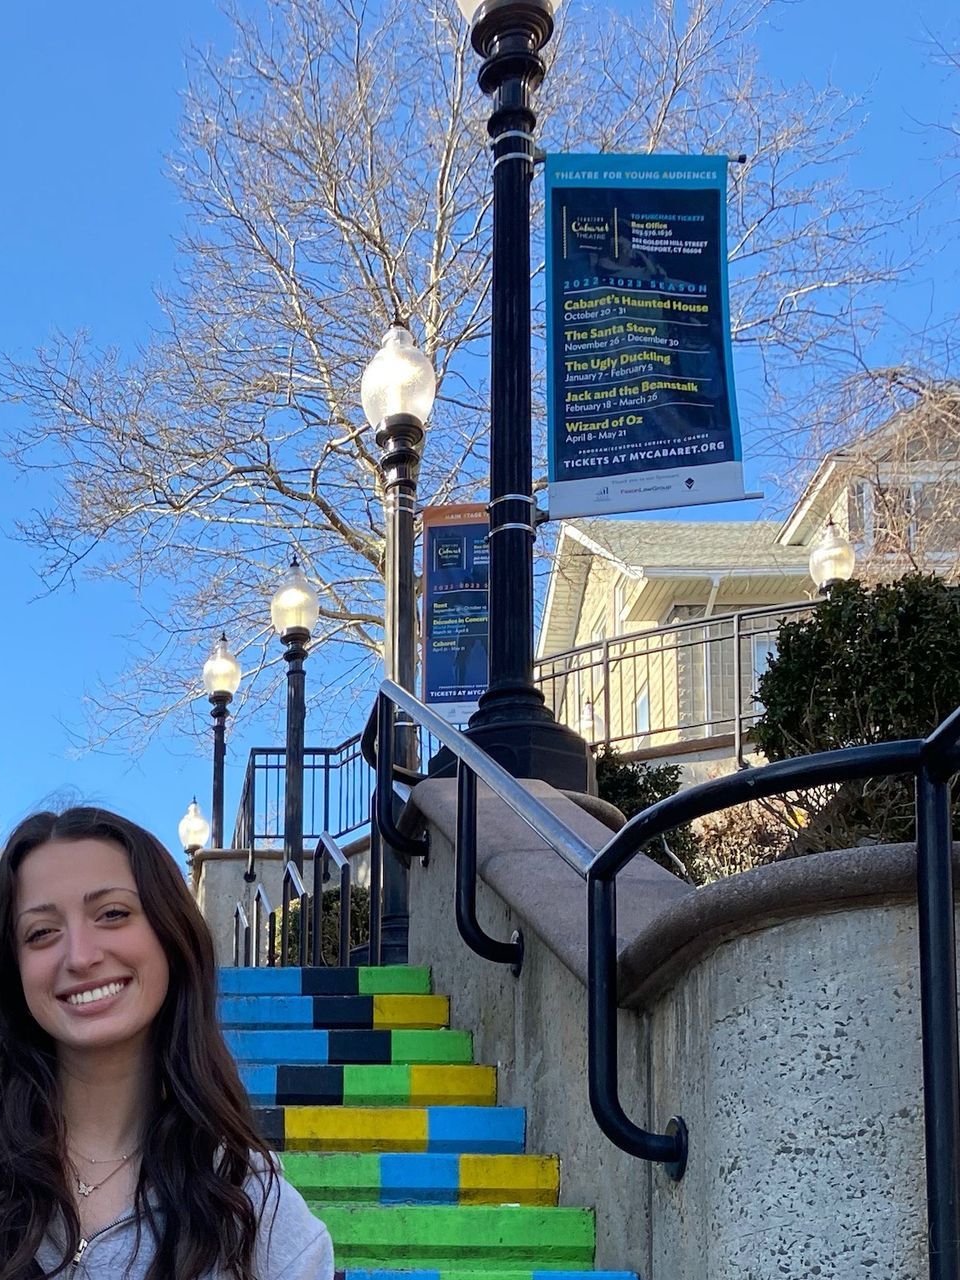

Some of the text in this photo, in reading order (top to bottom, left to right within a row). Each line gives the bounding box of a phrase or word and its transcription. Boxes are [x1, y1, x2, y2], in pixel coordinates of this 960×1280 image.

[555, 171, 717, 180] THEATRE FOR YOUNG AUDIENCES
[684, 240, 708, 248] STREET
[650, 280, 707, 293] SEASON
[564, 295, 709, 312] Cabaret's Haunted House
[564, 310, 599, 321] October
[618, 307, 627, 316] 31
[565, 322, 657, 341] The Santa Story
[565, 340, 608, 352] November
[609, 337, 620, 346] 26
[627, 333, 668, 344] December
[668, 339, 679, 347] 30
[565, 352, 671, 372] The Ugly Duckling
[565, 372, 596, 382] January
[598, 372, 603, 381] 7
[611, 364, 646, 378] February
[647, 363, 654, 371] 5
[565, 380, 698, 403] Jack and the Beanstalk
[565, 401, 602, 413] February
[602, 400, 611, 409] 18
[619, 396, 646, 407] March
[647, 392, 658, 402] 26
[566, 414, 643, 432] Wizard of Oz
[566, 432, 586, 444] April
[598, 430, 617, 441] May
[618, 429, 627, 437] 21
[563, 441, 725, 468] TICKETS AT MYCABARET.ORG
[430, 690, 456, 698] TICKETS
